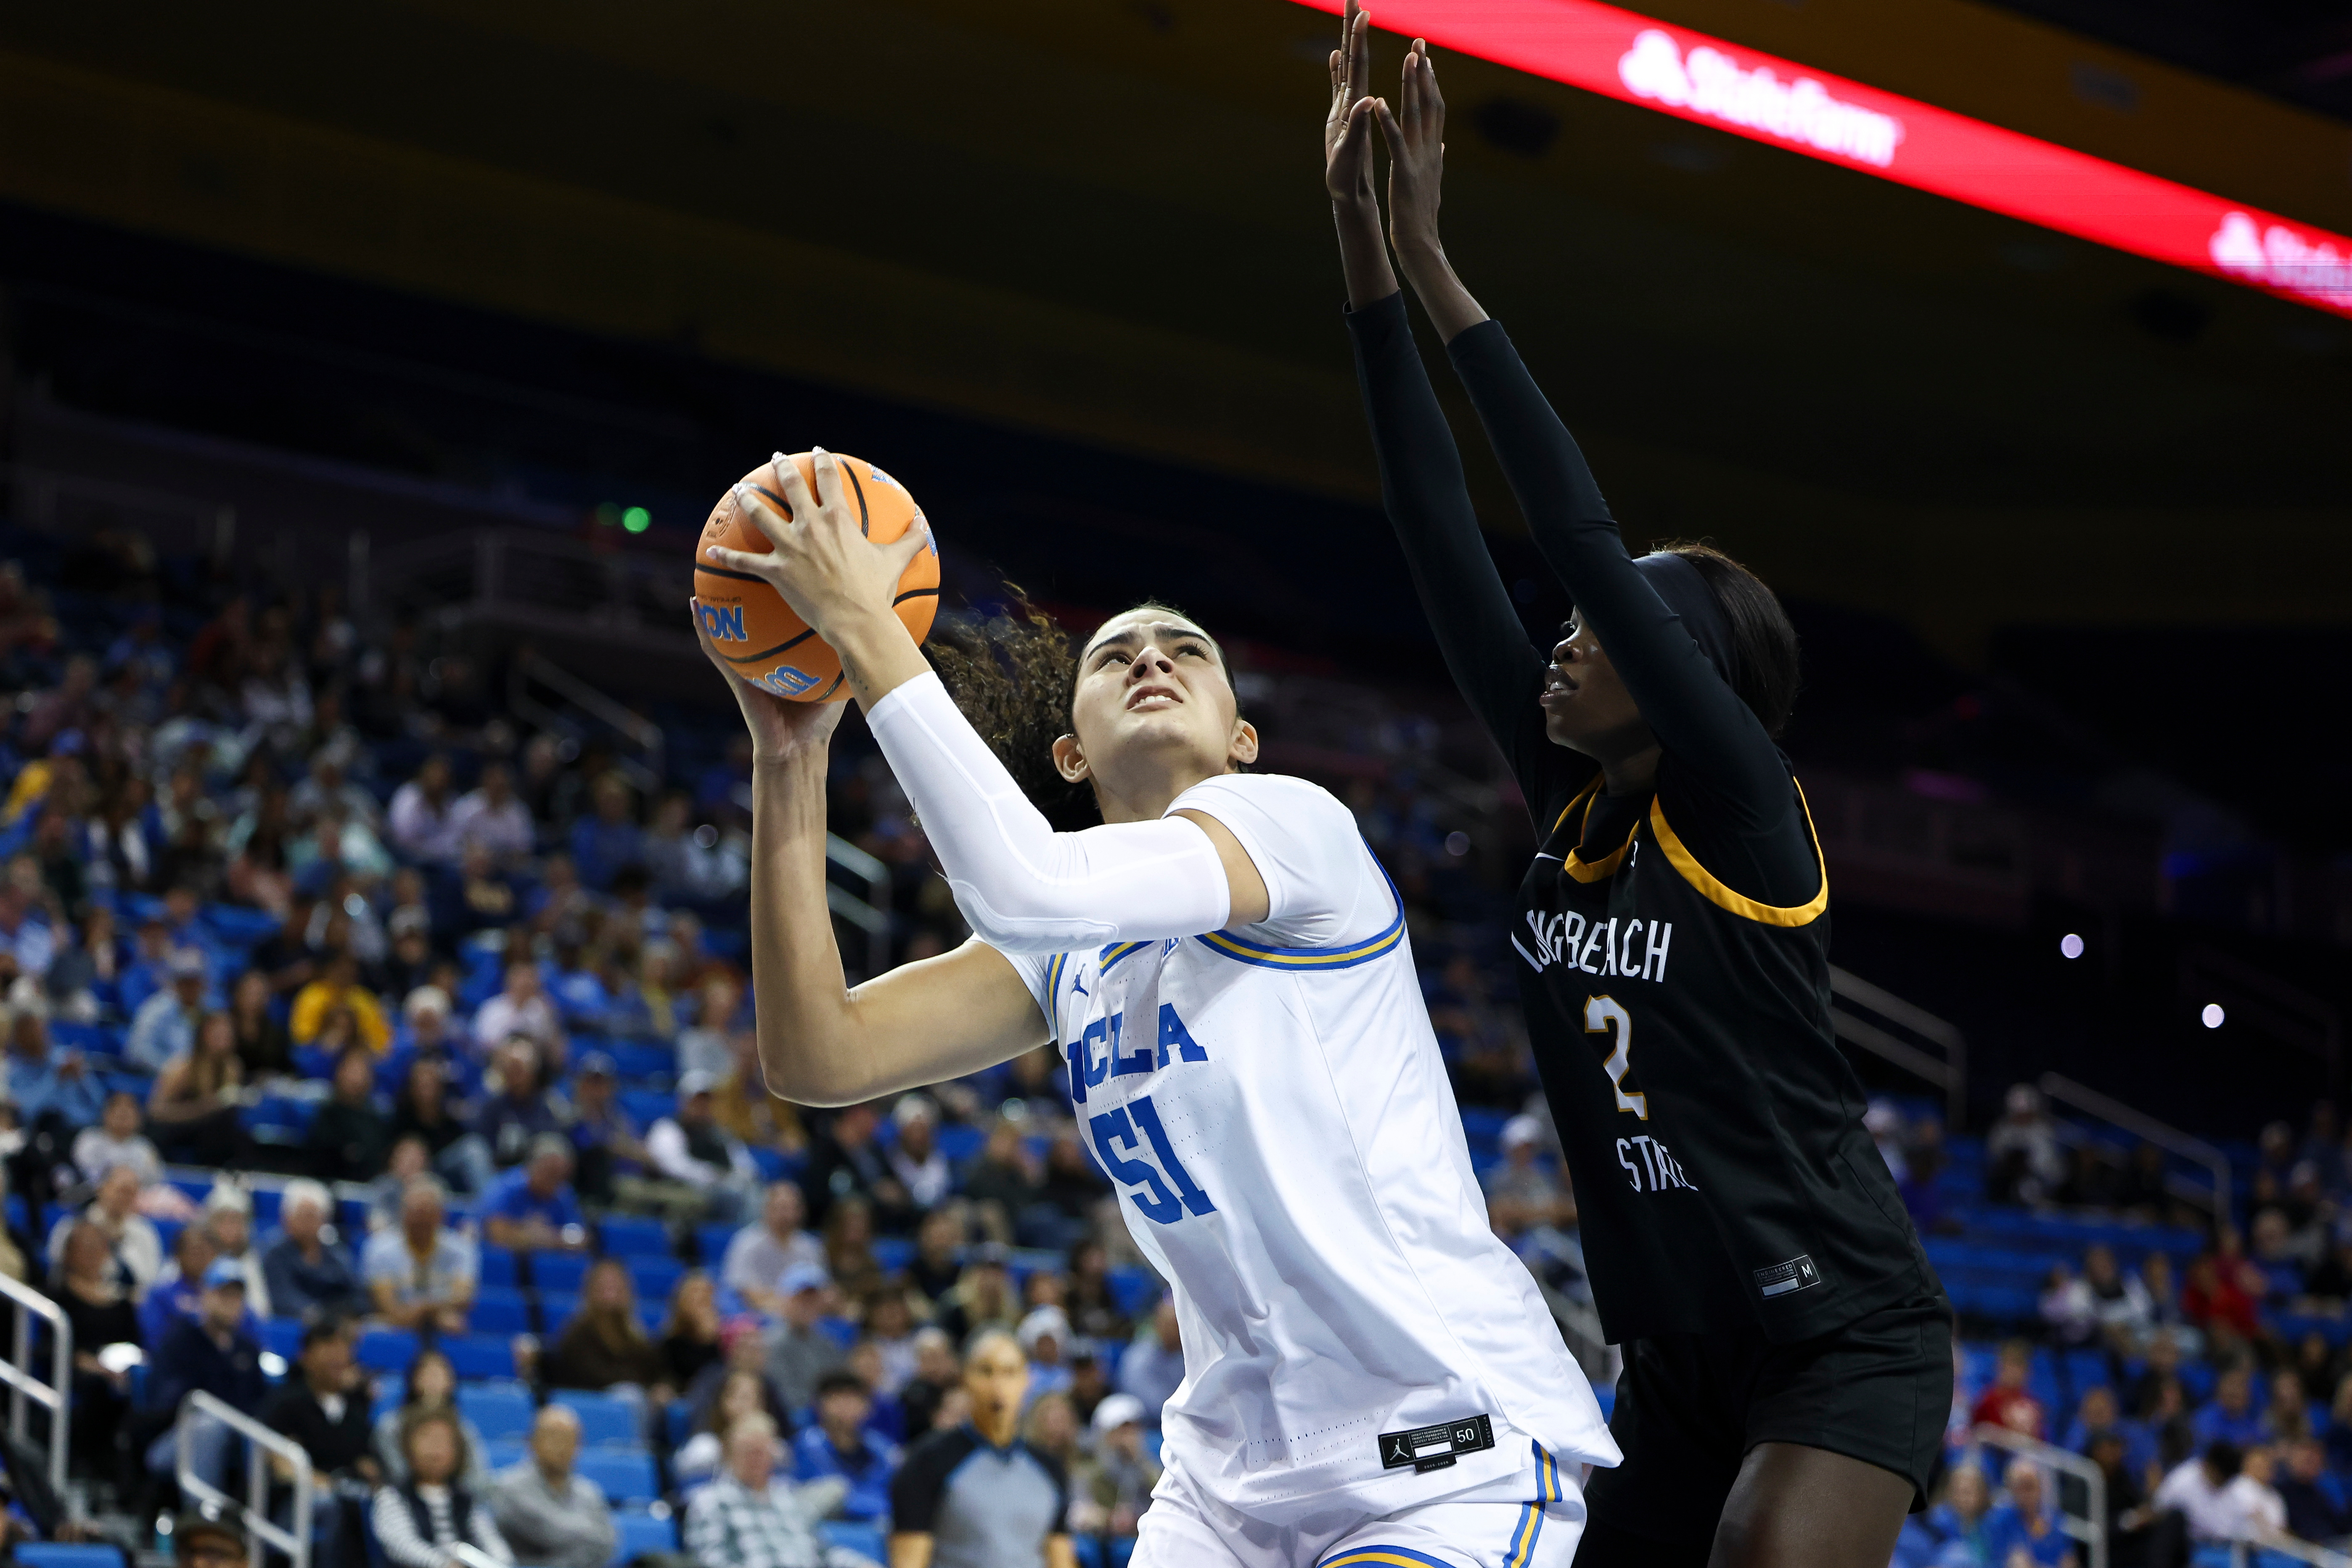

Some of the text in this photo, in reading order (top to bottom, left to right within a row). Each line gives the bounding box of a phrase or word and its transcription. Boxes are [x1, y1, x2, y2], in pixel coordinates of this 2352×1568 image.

[1583, 995, 1648, 1121] 2
[1089, 1095, 1217, 1224] 51
[1801, 1264, 1812, 1278] M
[1456, 1428, 1474, 1443] 50
